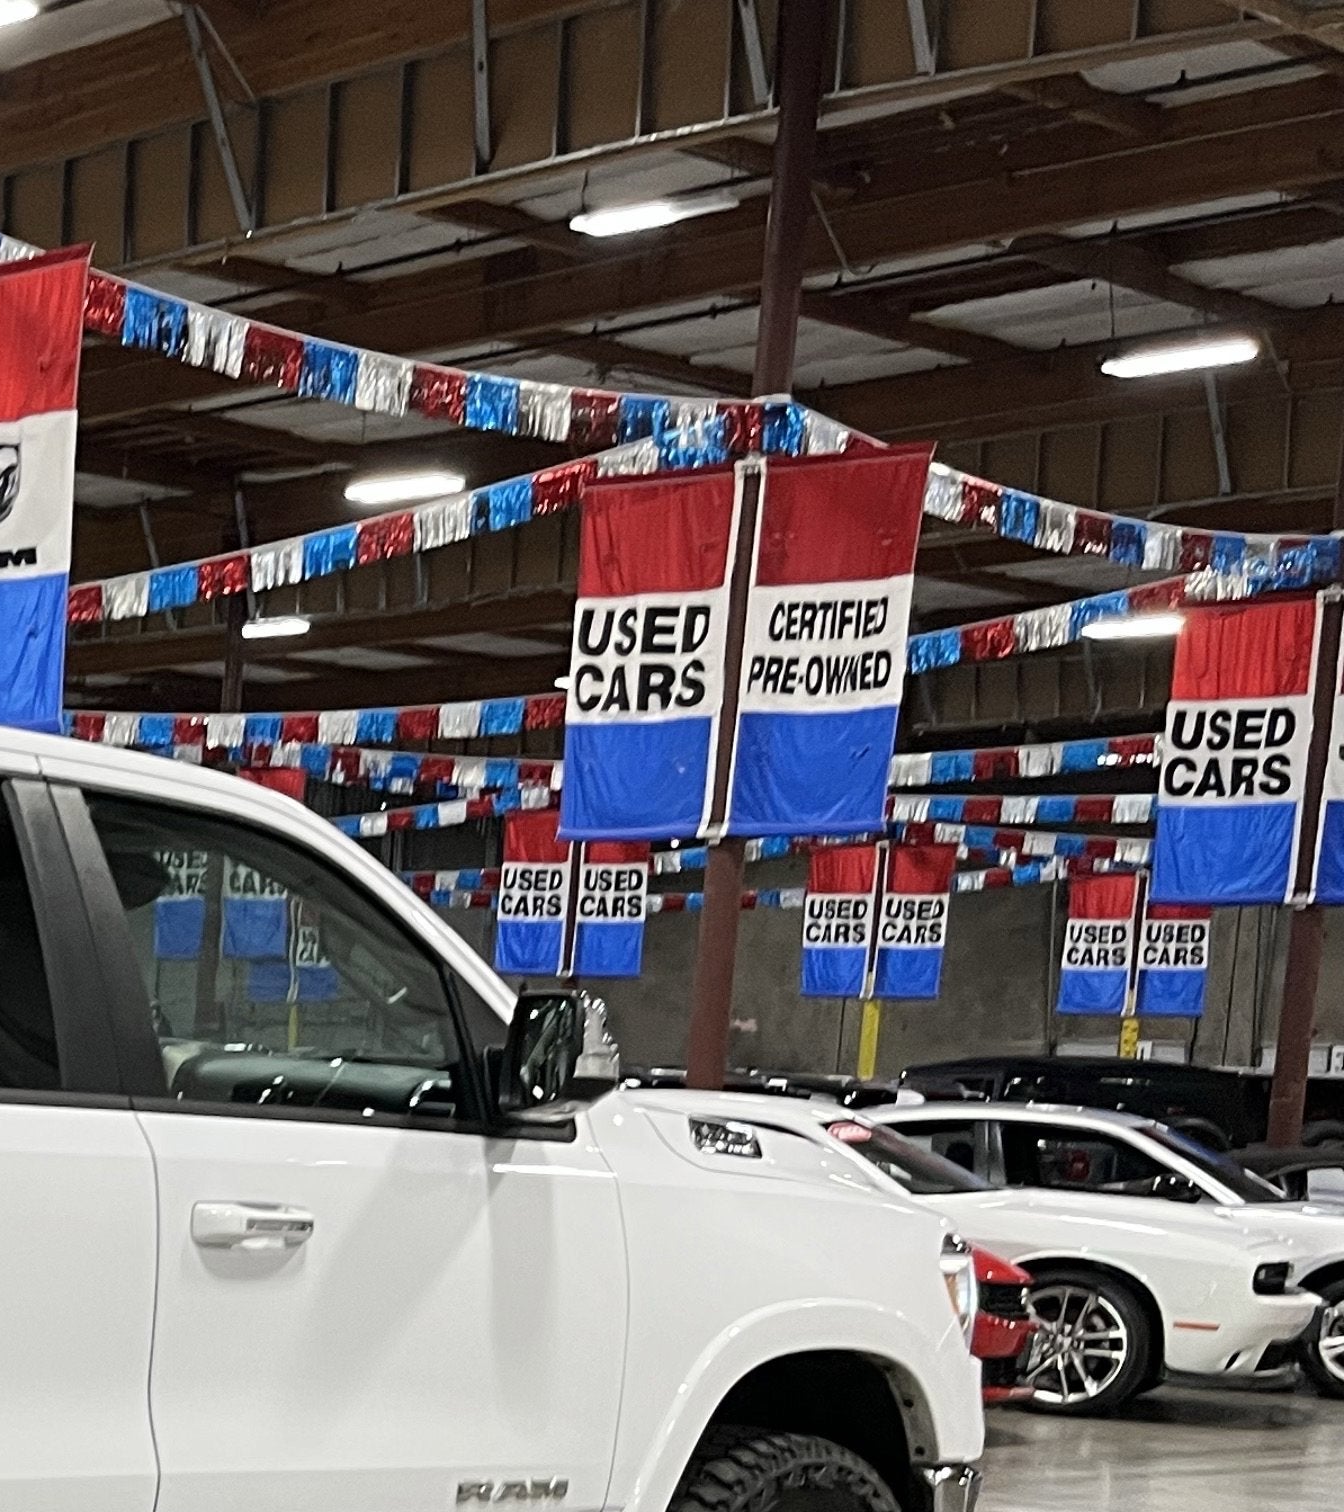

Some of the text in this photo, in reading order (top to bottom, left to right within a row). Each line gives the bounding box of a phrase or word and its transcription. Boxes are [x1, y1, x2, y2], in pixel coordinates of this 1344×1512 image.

[577, 605, 712, 657] USED
[768, 596, 889, 643] CERTIFIED
[746, 650, 893, 697] PRE-OWNED
[574, 659, 707, 713] CARS
[1170, 707, 1297, 751] USED
[1163, 754, 1292, 799] CARS
[502, 868, 563, 892] USED
[582, 868, 644, 892] USED
[499, 895, 563, 919] CARS
[578, 895, 643, 919] CARS
[809, 899, 868, 921] USED
[884, 898, 946, 921] USED
[804, 923, 867, 945] CARS
[880, 922, 943, 945] CARS
[1069, 923, 1127, 945] USED
[1145, 923, 1207, 945] USED
[1066, 946, 1127, 967] CARS
[1142, 946, 1205, 967] CARS
